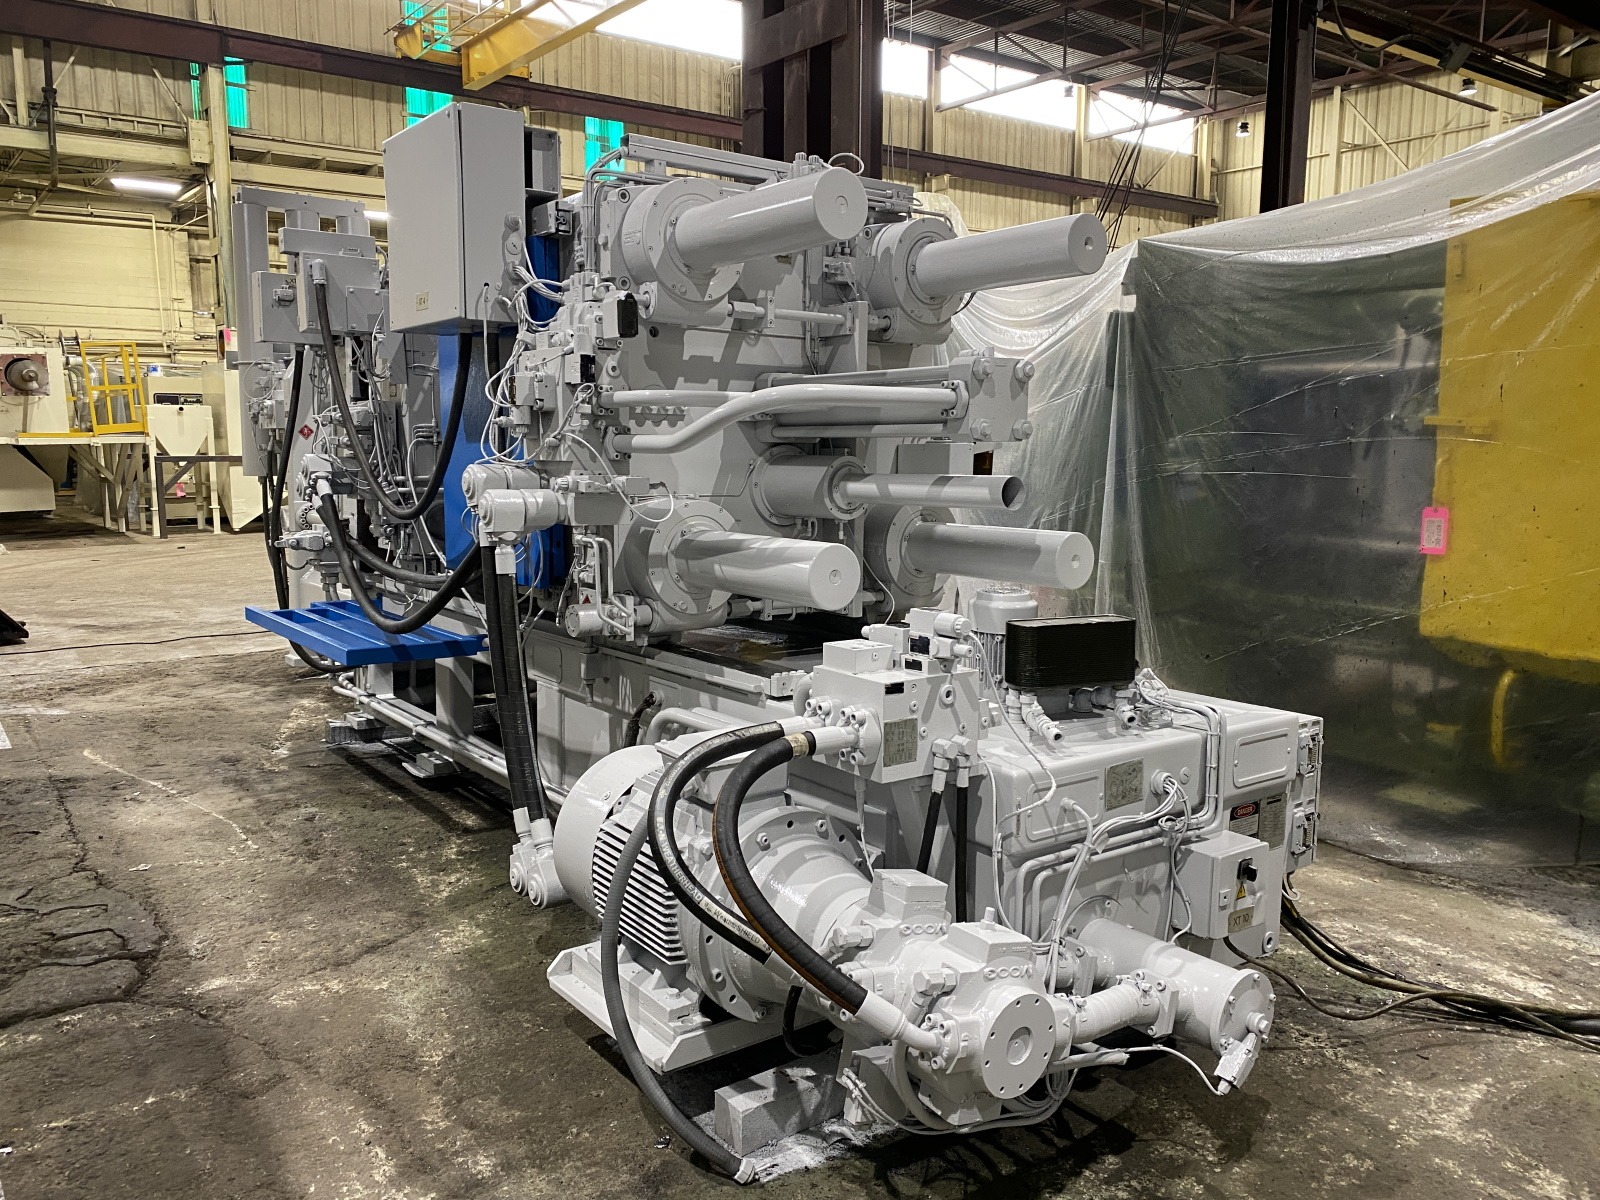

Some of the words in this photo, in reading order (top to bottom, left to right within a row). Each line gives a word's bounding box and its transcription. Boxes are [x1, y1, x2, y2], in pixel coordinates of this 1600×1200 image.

[1237, 806, 1253, 816] DANGER
[661, 842, 703, 901] WEATHERHEAD
[1232, 915, 1241, 927] XT
[1242, 913, 1250, 923] 10
